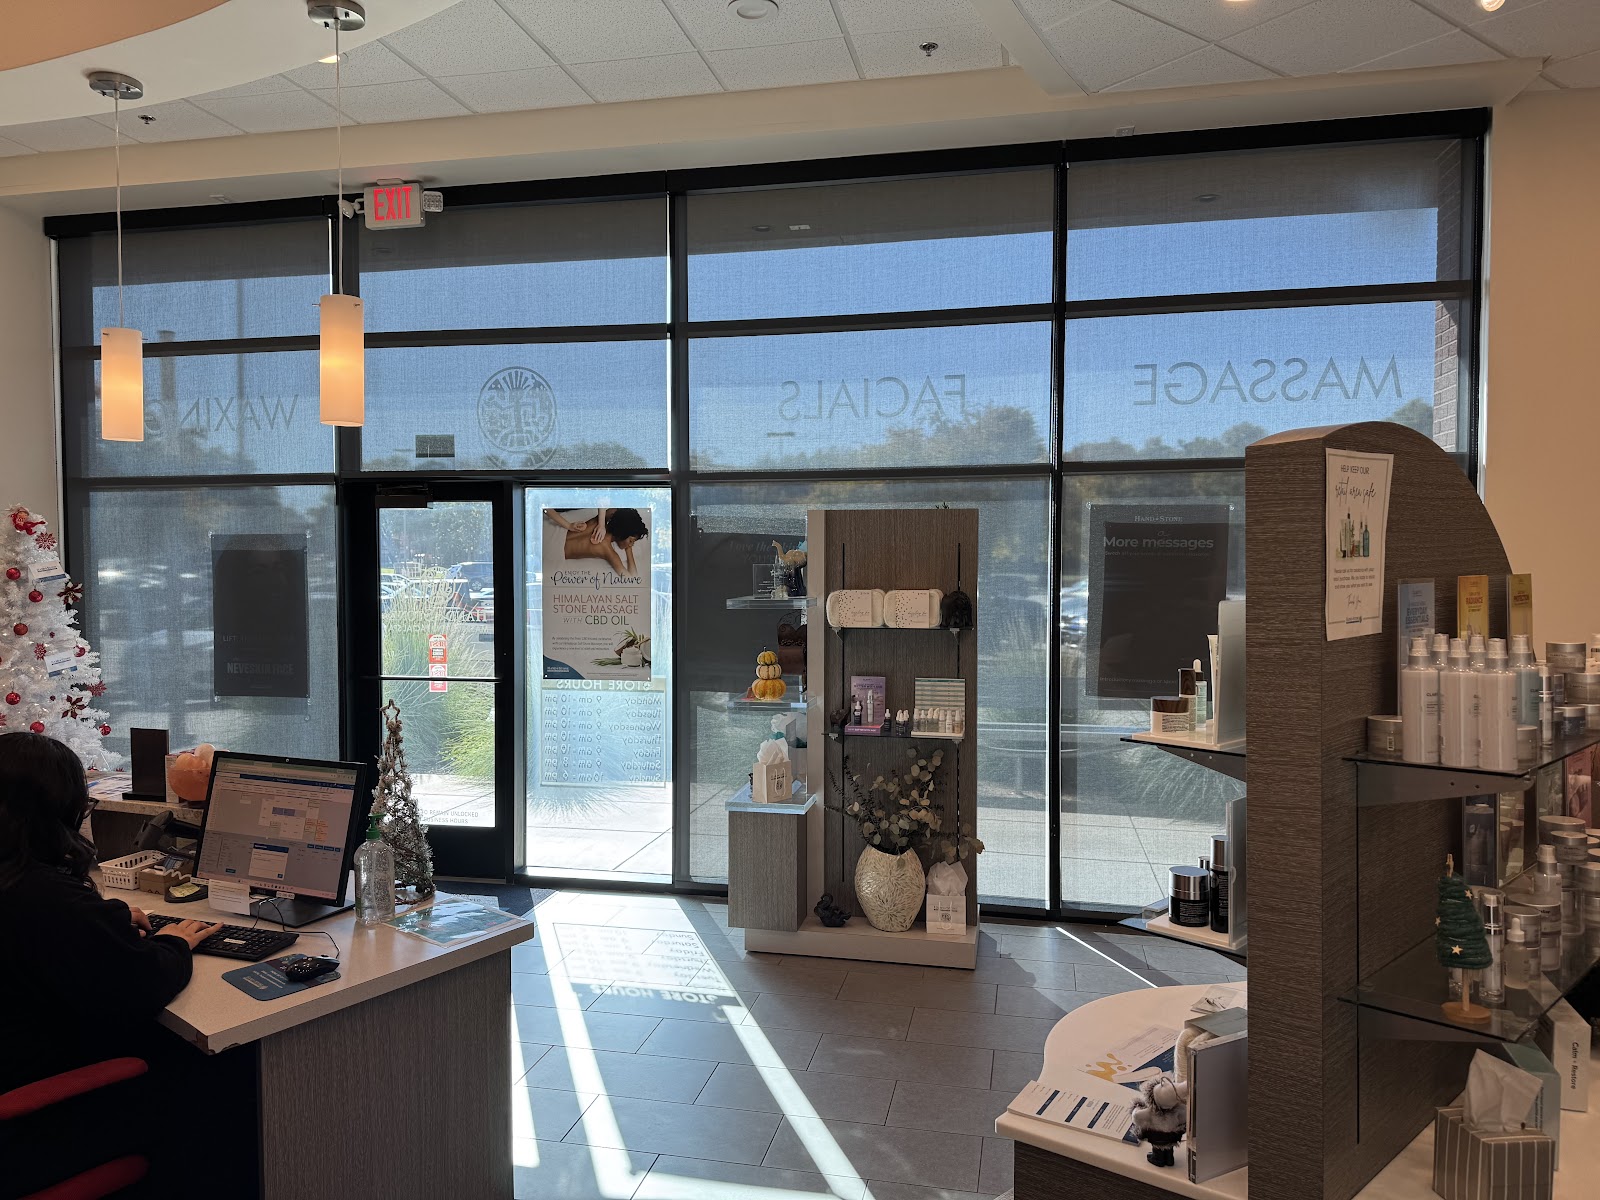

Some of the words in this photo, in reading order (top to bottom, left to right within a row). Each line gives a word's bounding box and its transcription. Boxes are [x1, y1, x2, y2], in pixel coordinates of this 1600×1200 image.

[373, 186, 413, 221] EXIT
[1360, 466, 1370, 475] OUR
[1103, 536, 1139, 548] More
[1142, 538, 1214, 551] messages
[550, 570, 588, 586] Power
[589, 572, 601, 591] of
[602, 571, 643, 585] Nature
[553, 594, 613, 604] HIMALAYAN
[615, 594, 639, 604] SALT
[553, 604, 587, 614] STONE
[590, 604, 639, 615] MASSAGE
[584, 614, 608, 625] CBD
[611, 615, 630, 626] OIL
[589, 983, 654, 999] HOURS
[661, 990, 719, 1005] STORE
[1571, 1041, 1580, 1059] Calm
[1570, 1064, 1579, 1090] Restore
